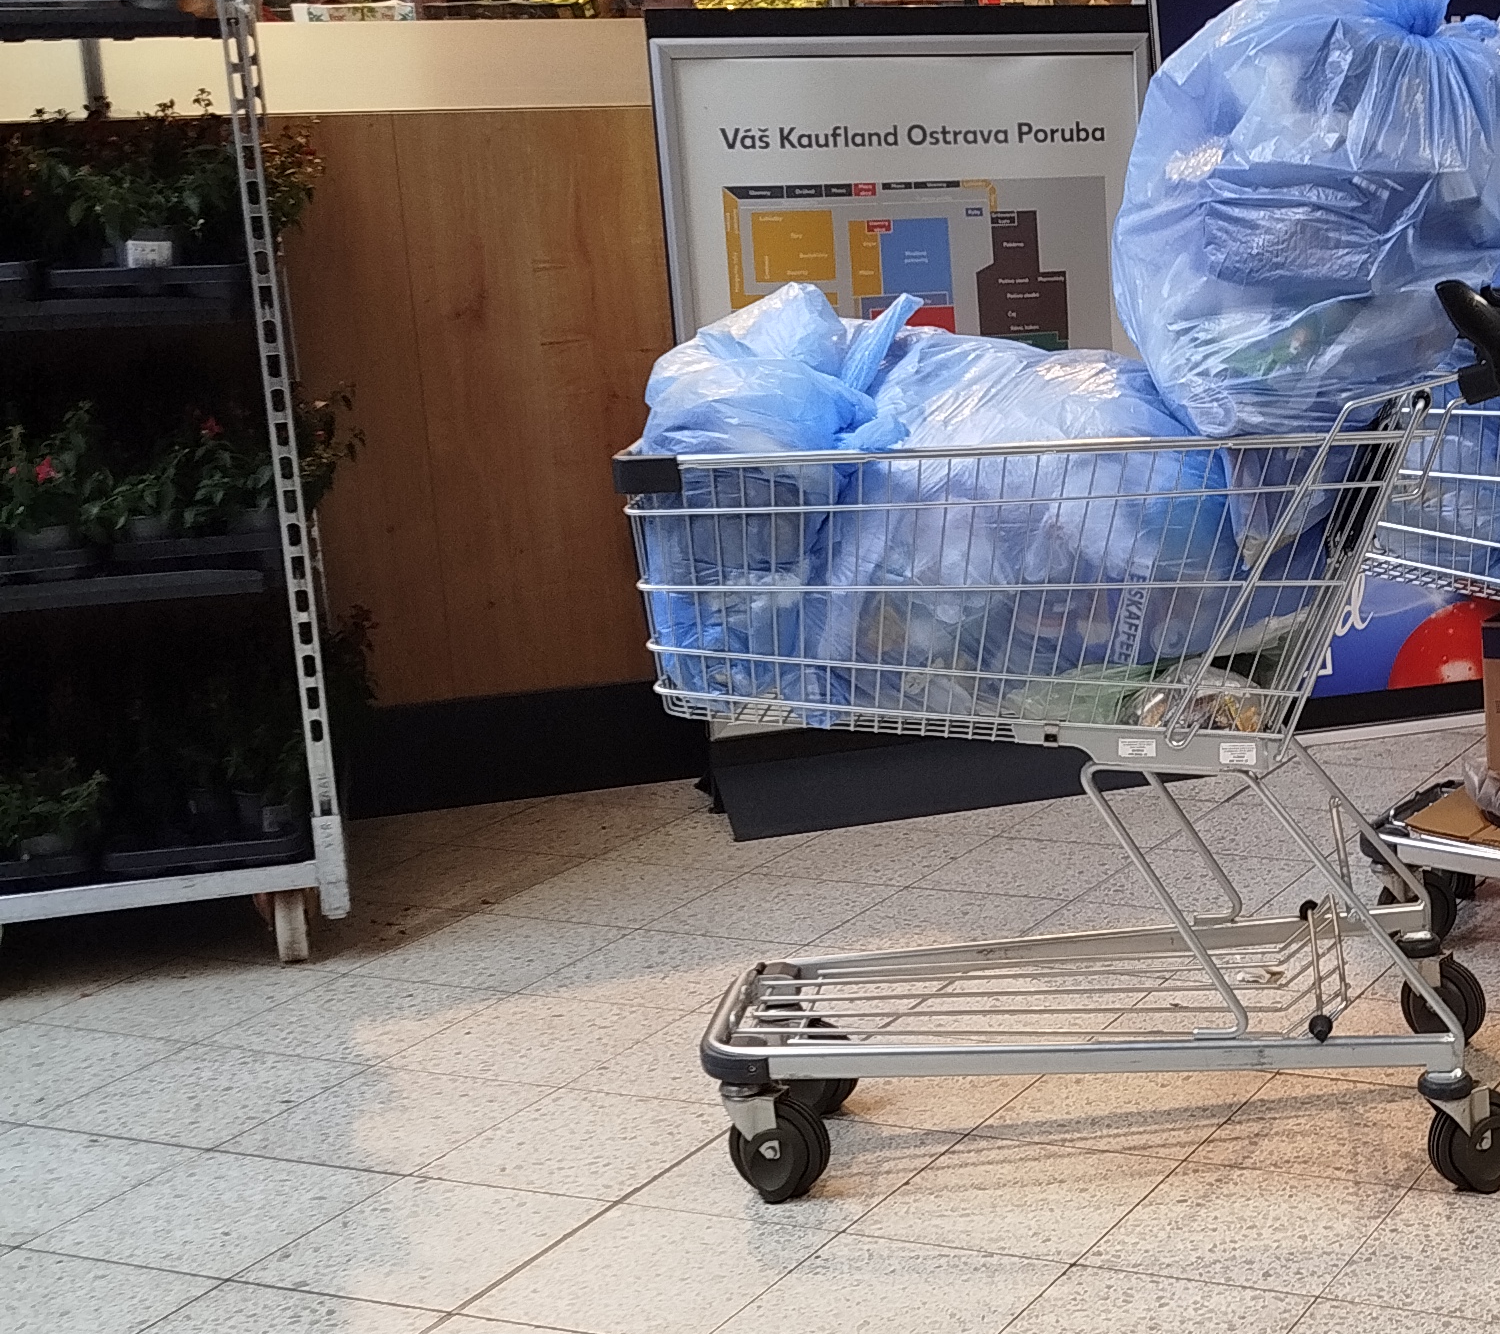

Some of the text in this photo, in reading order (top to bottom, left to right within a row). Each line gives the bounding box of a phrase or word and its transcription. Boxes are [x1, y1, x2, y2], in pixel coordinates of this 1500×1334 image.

[719, 121, 1106, 150] Váš Kaufland Ostrava Poruba
